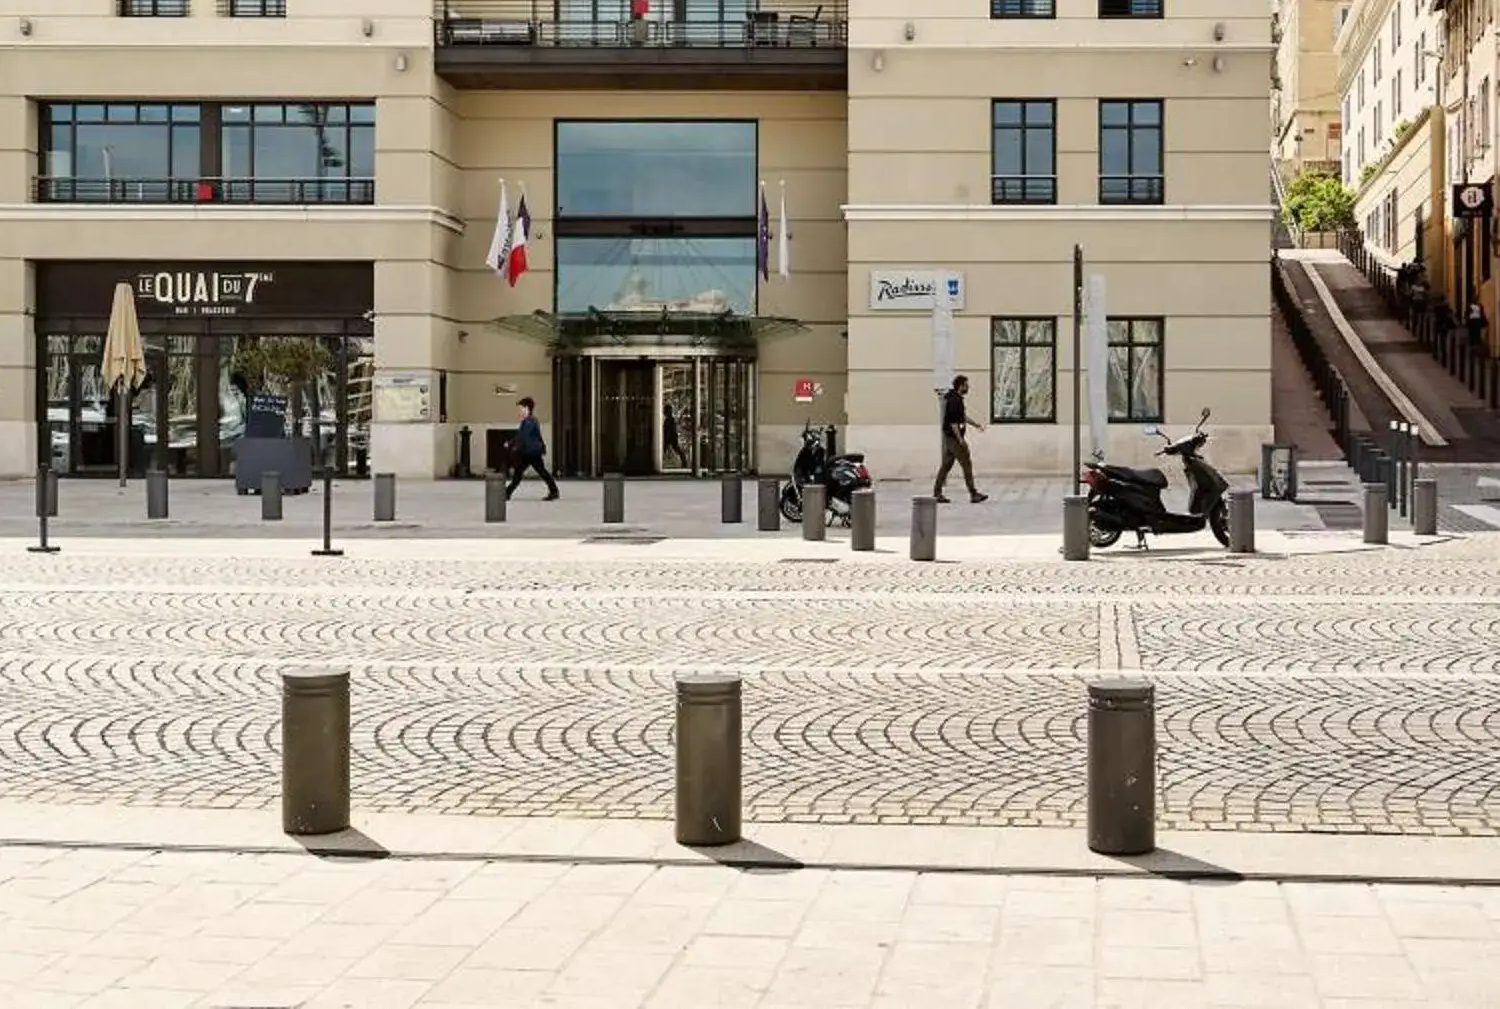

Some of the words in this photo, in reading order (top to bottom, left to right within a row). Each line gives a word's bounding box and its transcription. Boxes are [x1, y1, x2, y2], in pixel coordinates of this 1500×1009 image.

[139, 279, 153, 293] LE
[155, 272, 219, 303] QUAI
[223, 280, 241, 293] DU
[878, 277, 937, 301] Radisso
